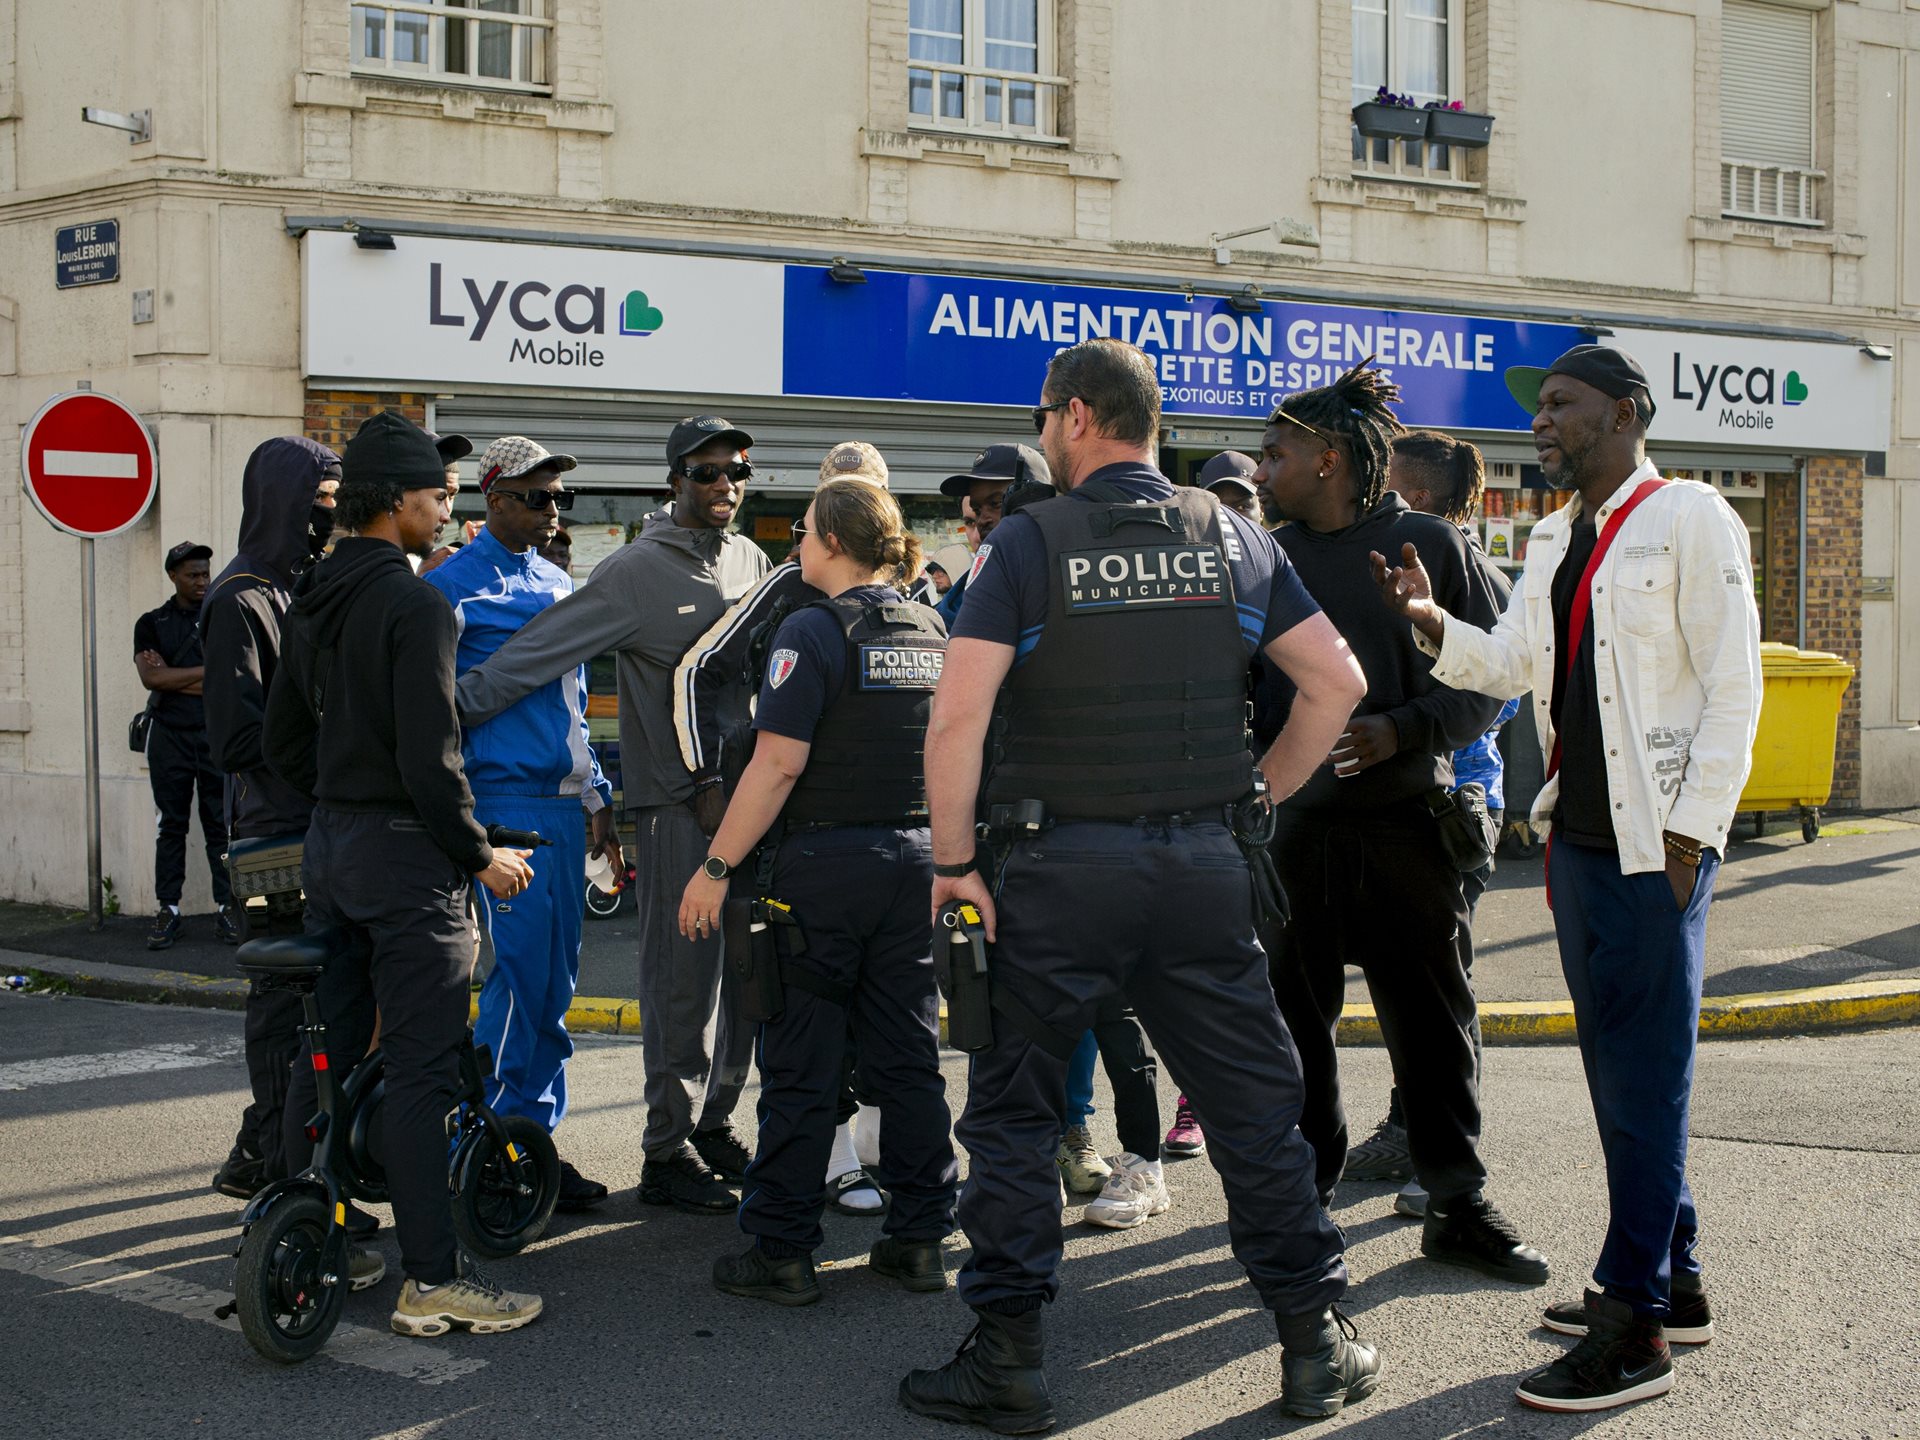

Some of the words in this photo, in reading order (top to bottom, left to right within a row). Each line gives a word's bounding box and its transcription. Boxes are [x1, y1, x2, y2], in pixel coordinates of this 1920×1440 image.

[75, 226, 97, 243] RUE
[430, 262, 605, 341] Lyca
[928, 293, 1272, 356] ALIMENTATION
[1286, 319, 1494, 372] GENERALE
[509, 338, 604, 367] Mobile
[1673, 352, 1775, 411] Lyca
[1160, 386, 1244, 406] EXOTIQUES
[1249, 391, 1267, 406] ET
[697, 418, 723, 428] GUCCI
[1718, 408, 1774, 430] Mobile
[834, 454, 861, 465] GUCCI
[1068, 551, 1219, 587] POLICE
[1072, 582, 1221, 601] MUNICIPALE
[869, 651, 944, 668] POLICE
[841, 1170, 863, 1184] NIKE
